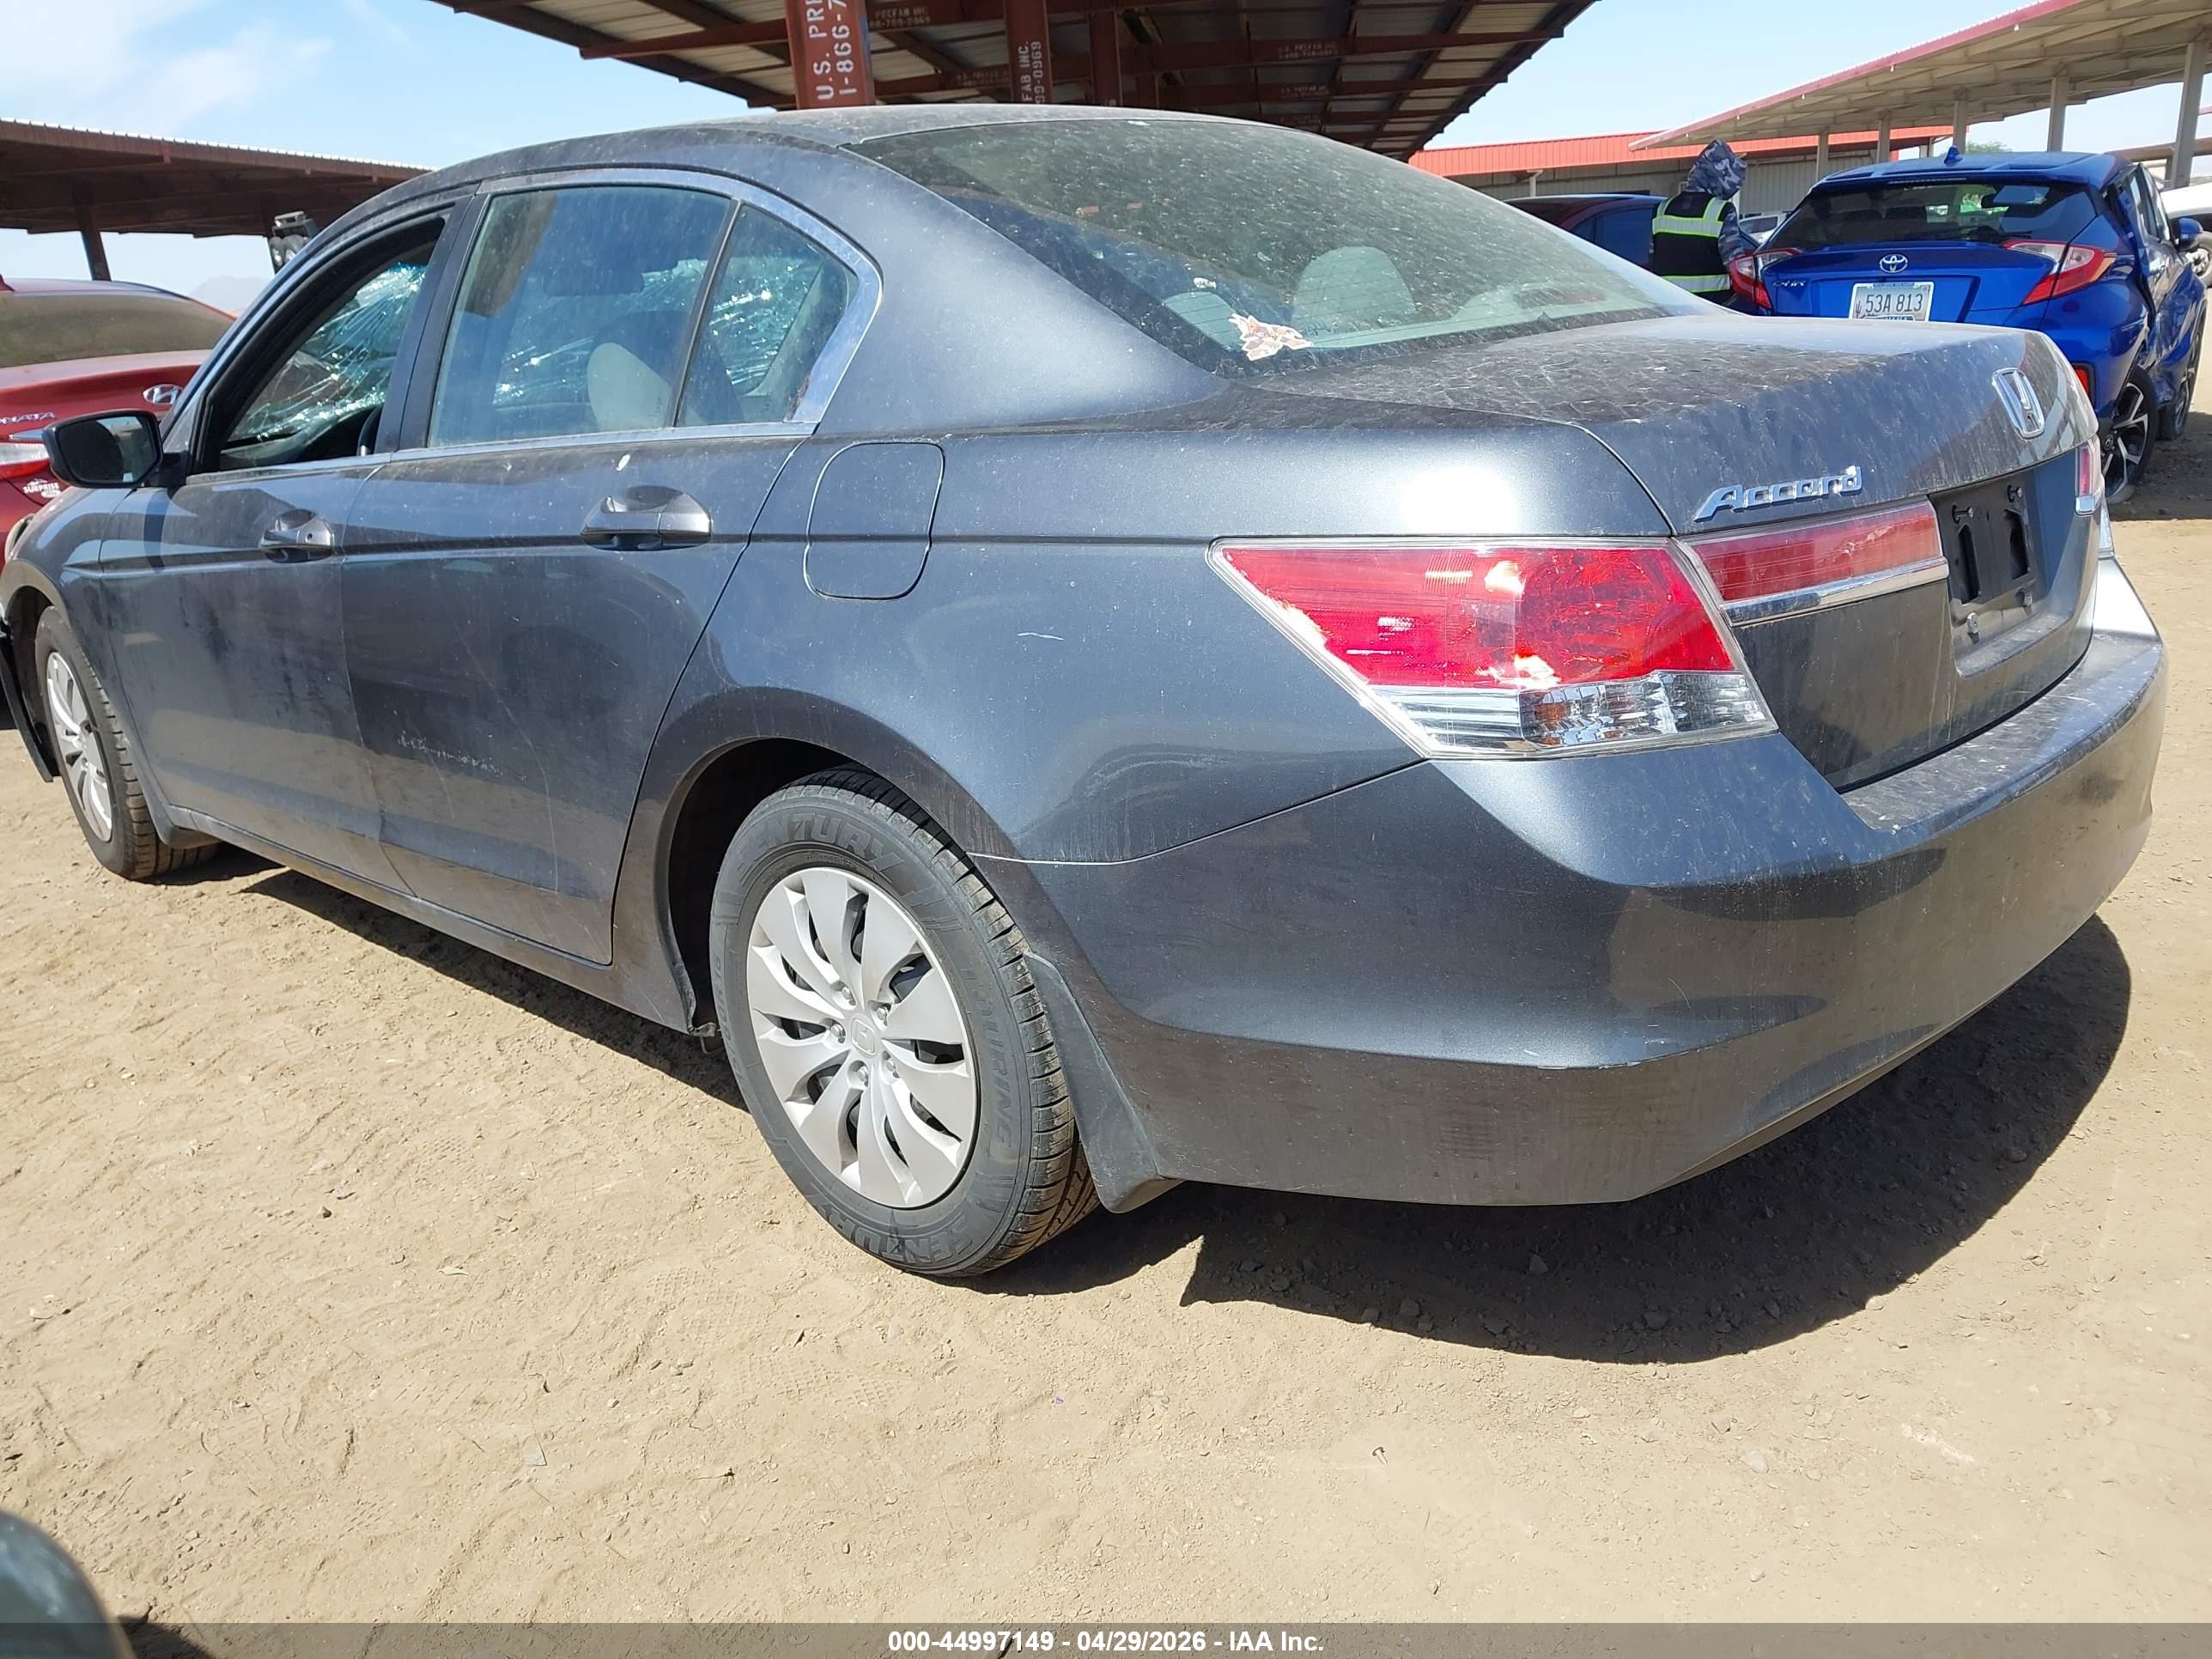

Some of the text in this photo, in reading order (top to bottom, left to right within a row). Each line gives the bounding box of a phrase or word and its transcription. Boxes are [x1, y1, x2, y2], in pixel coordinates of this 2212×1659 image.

[812, 52, 835, 100] U.S.
[1865, 293, 1923, 313] 53A 813
[1692, 465, 1863, 523] Accord
